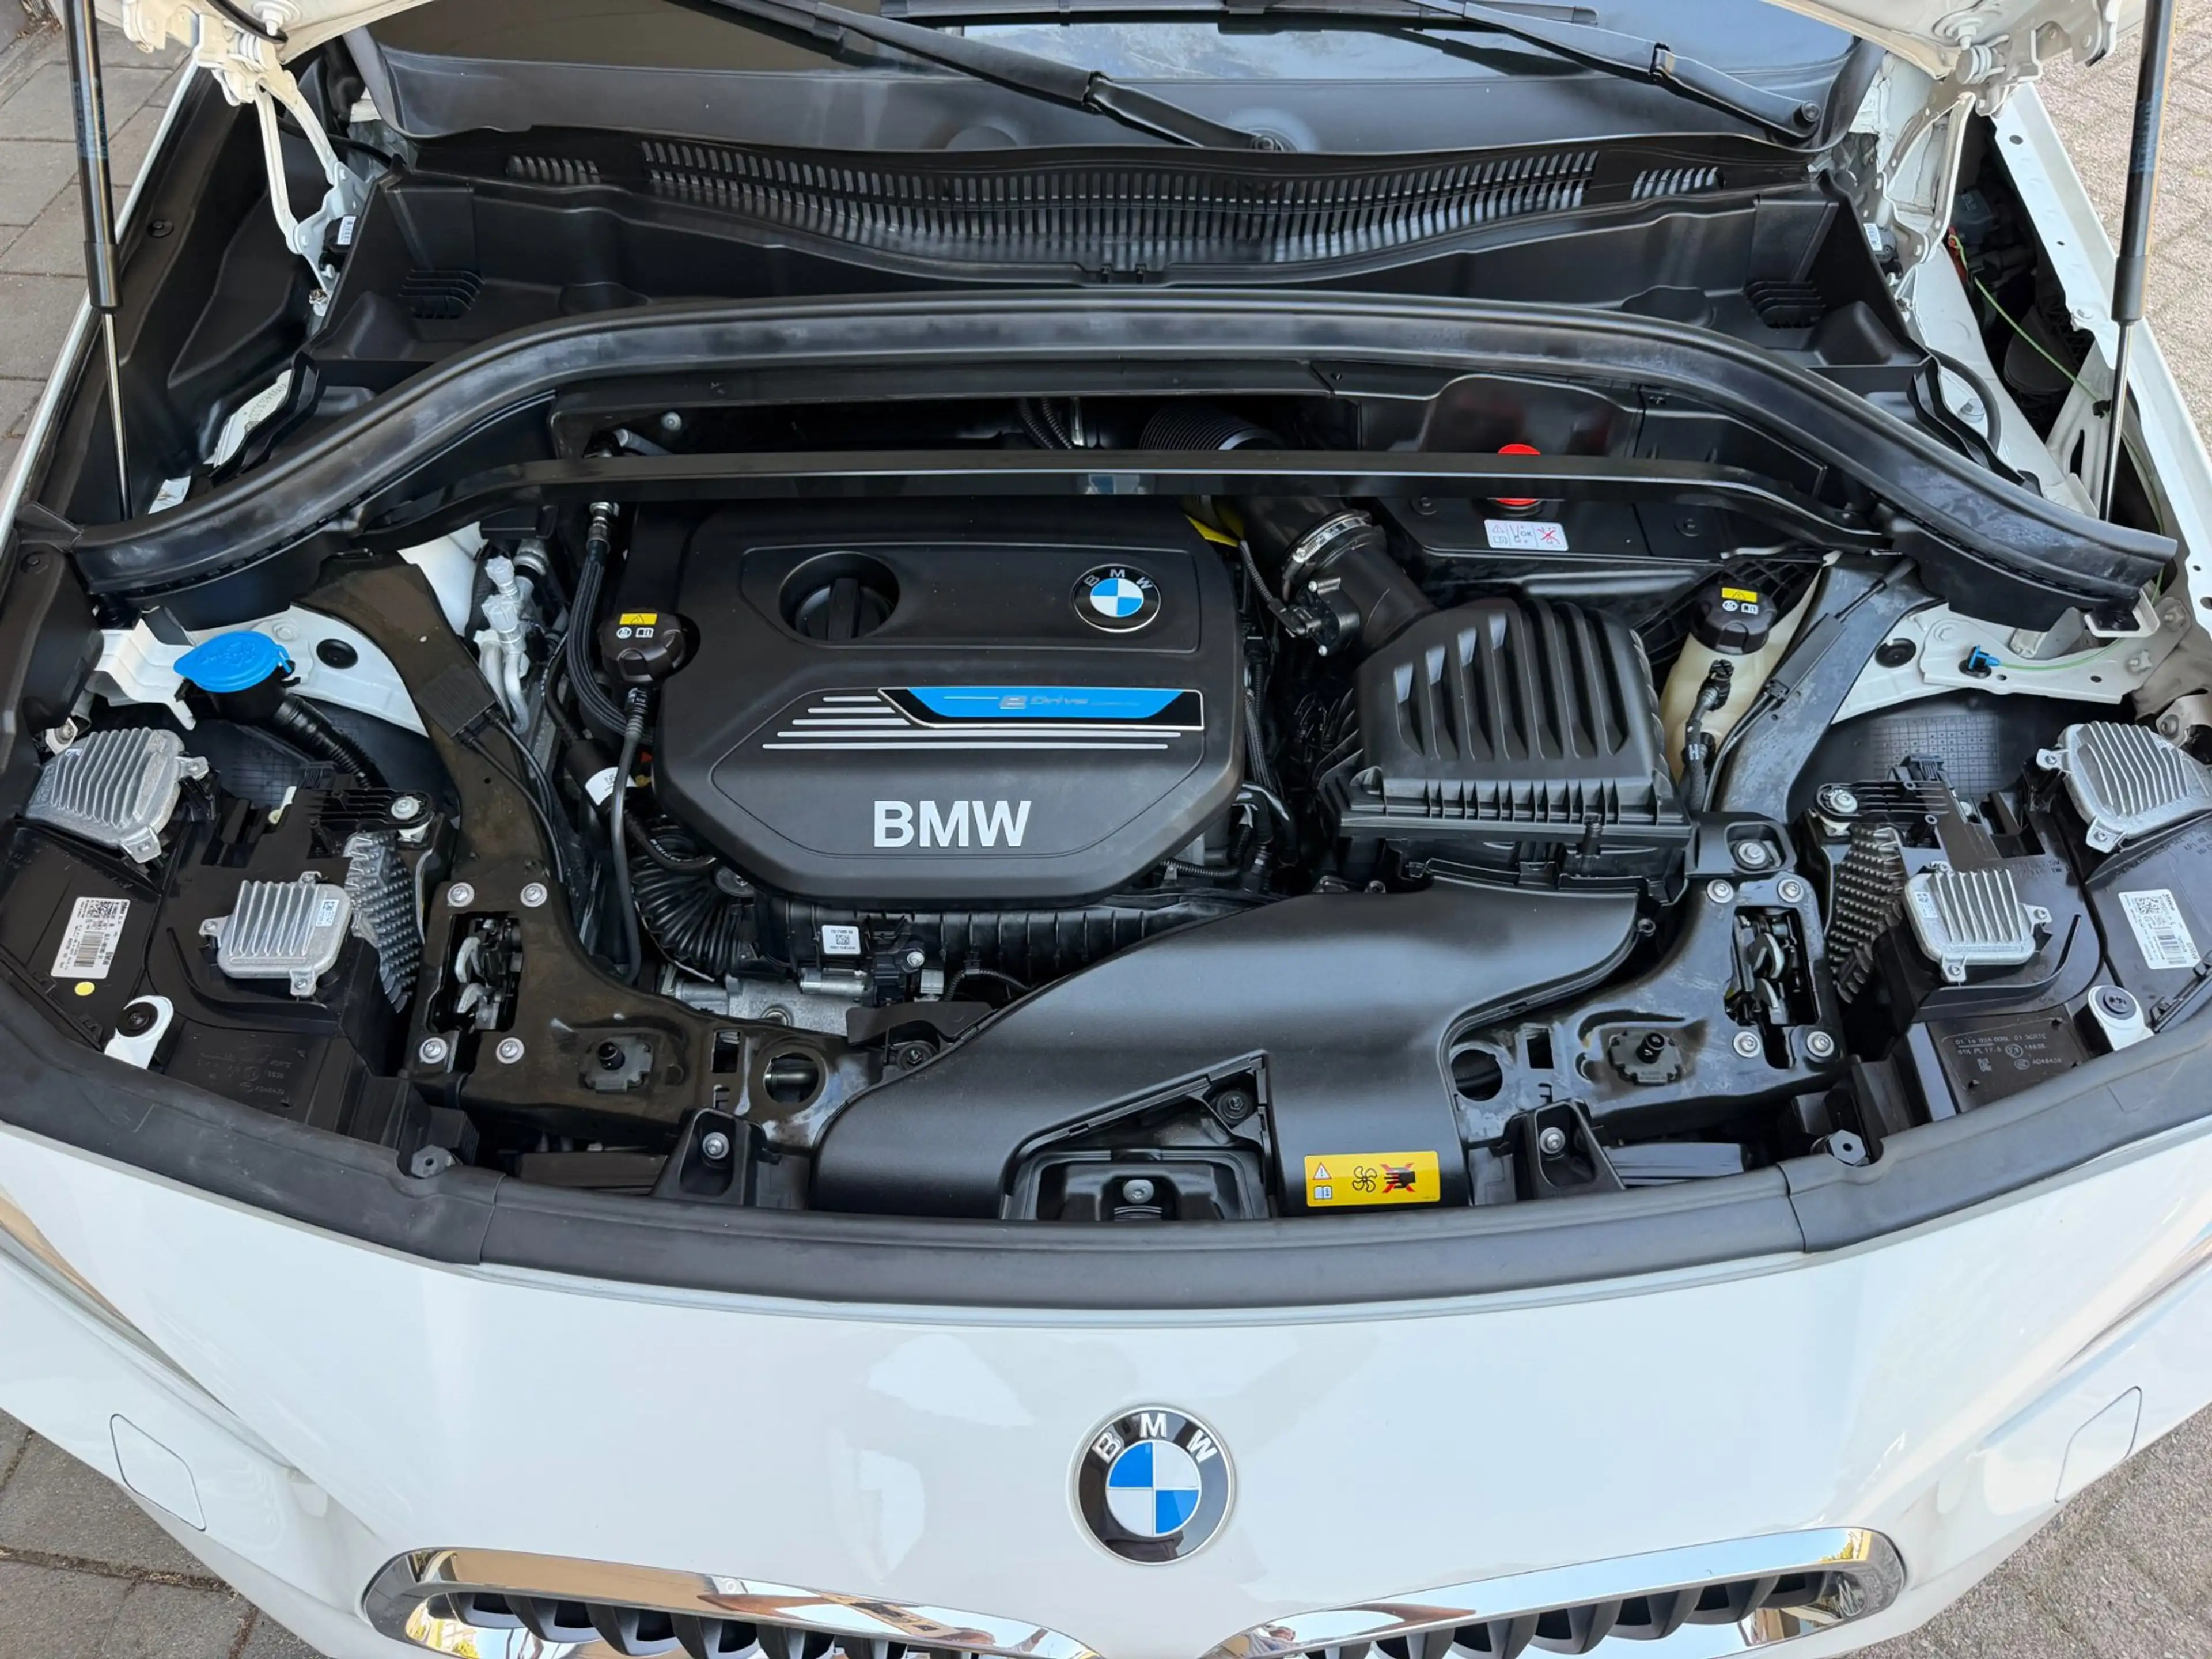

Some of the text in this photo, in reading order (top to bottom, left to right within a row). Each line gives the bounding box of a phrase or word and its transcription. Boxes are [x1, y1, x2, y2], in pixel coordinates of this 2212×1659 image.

[1084, 569, 1153, 589] BMW
[874, 800, 1032, 847] BMW
[1092, 1412, 1217, 1464] BMW
